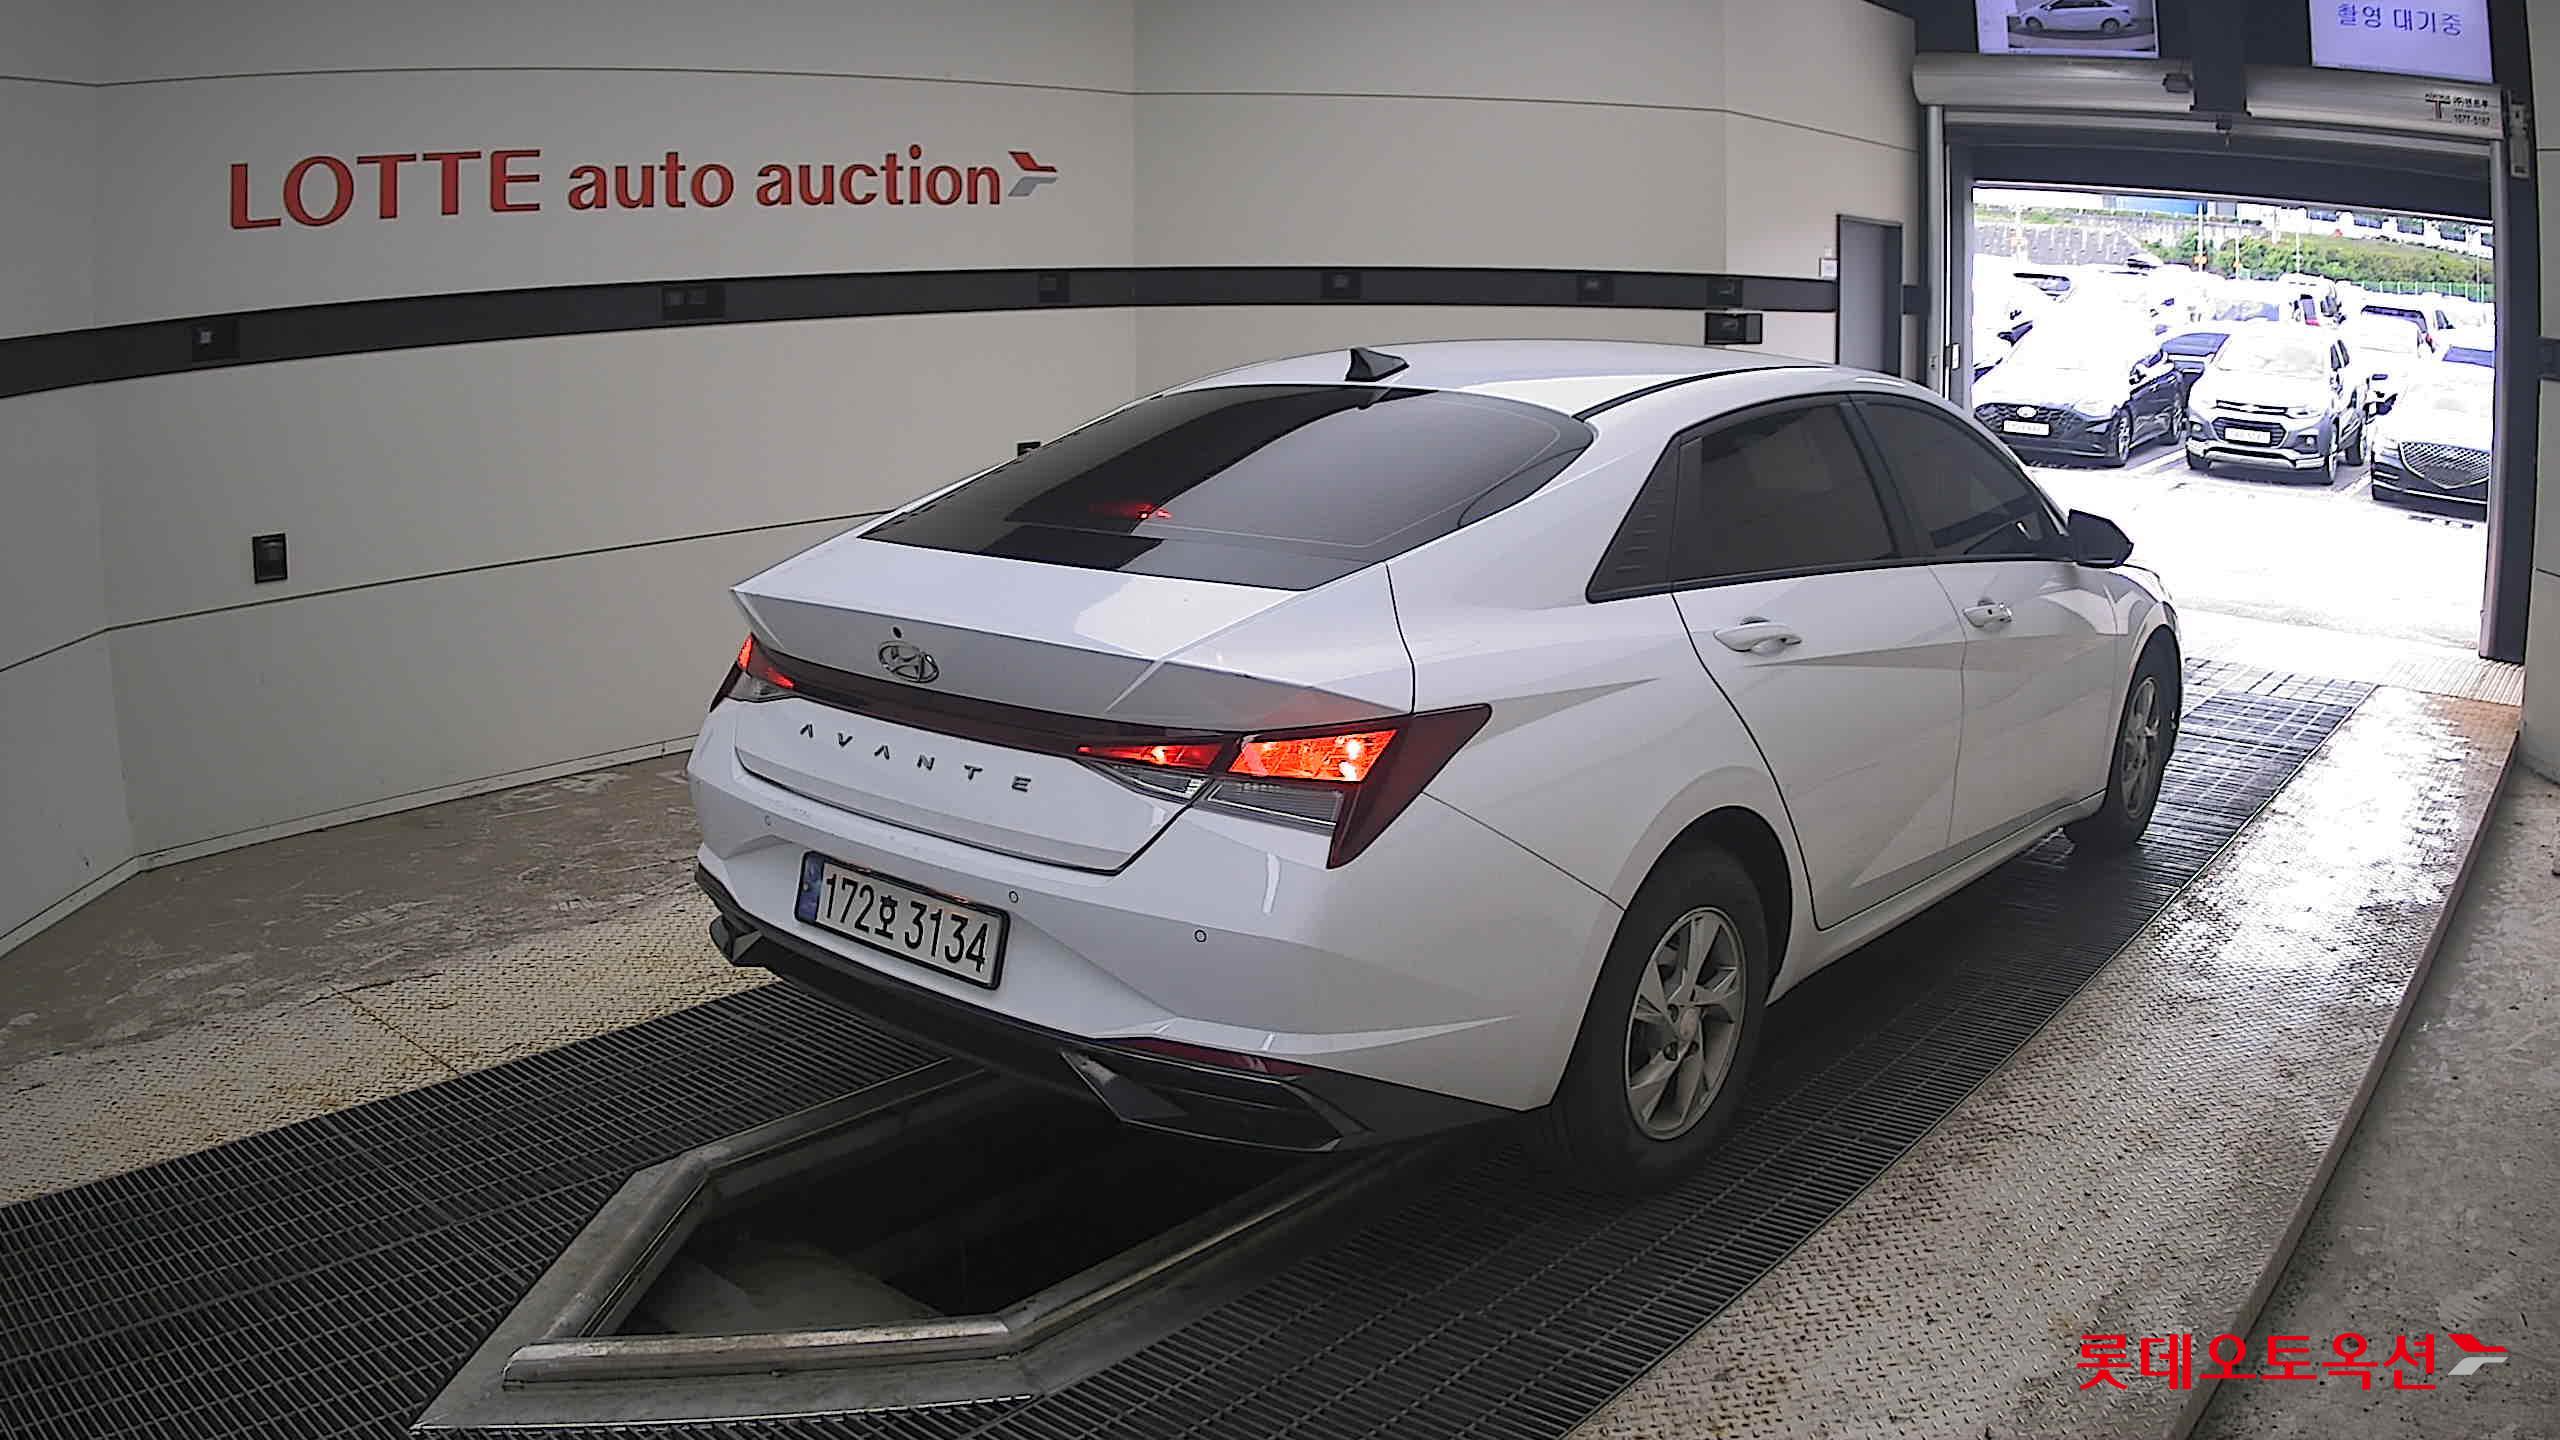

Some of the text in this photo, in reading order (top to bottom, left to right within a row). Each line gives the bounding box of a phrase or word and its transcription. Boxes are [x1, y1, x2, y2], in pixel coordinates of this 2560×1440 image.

[2337, 3, 2462, 37] 촬영 대기중
[230, 144, 1002, 230] LOTTE auto auction
[799, 723, 1032, 793] AVANTE
[825, 872, 989, 973] 172호 3134
